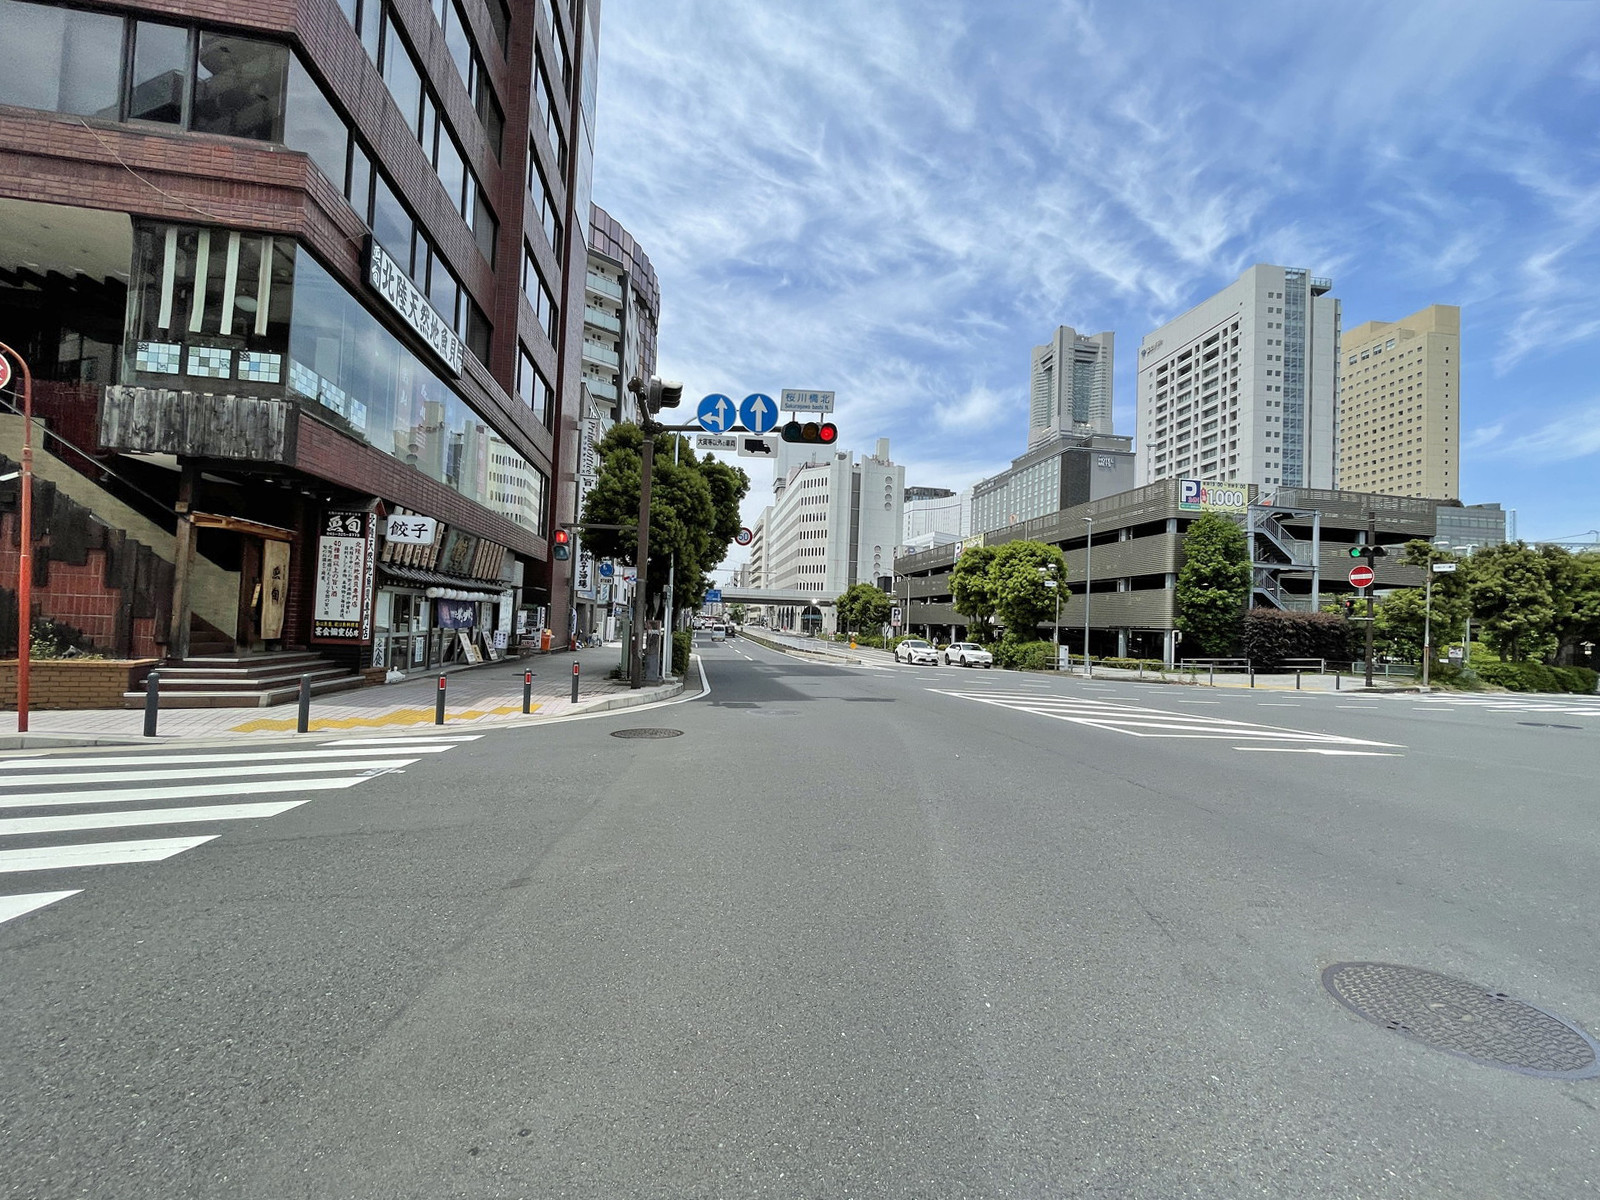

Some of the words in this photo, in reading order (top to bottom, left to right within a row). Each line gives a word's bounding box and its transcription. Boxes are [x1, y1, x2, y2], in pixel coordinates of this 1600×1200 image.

[382, 259, 457, 371] 北陸天然地魚貝
[786, 393, 830, 404] 桜川橋北
[697, 438, 736, 447] 大貨等以外の車両
[1182, 481, 1197, 502] P
[1207, 489, 1244, 507] 1,000
[389, 520, 428, 539] 餃子
[738, 532, 749, 541] 50
